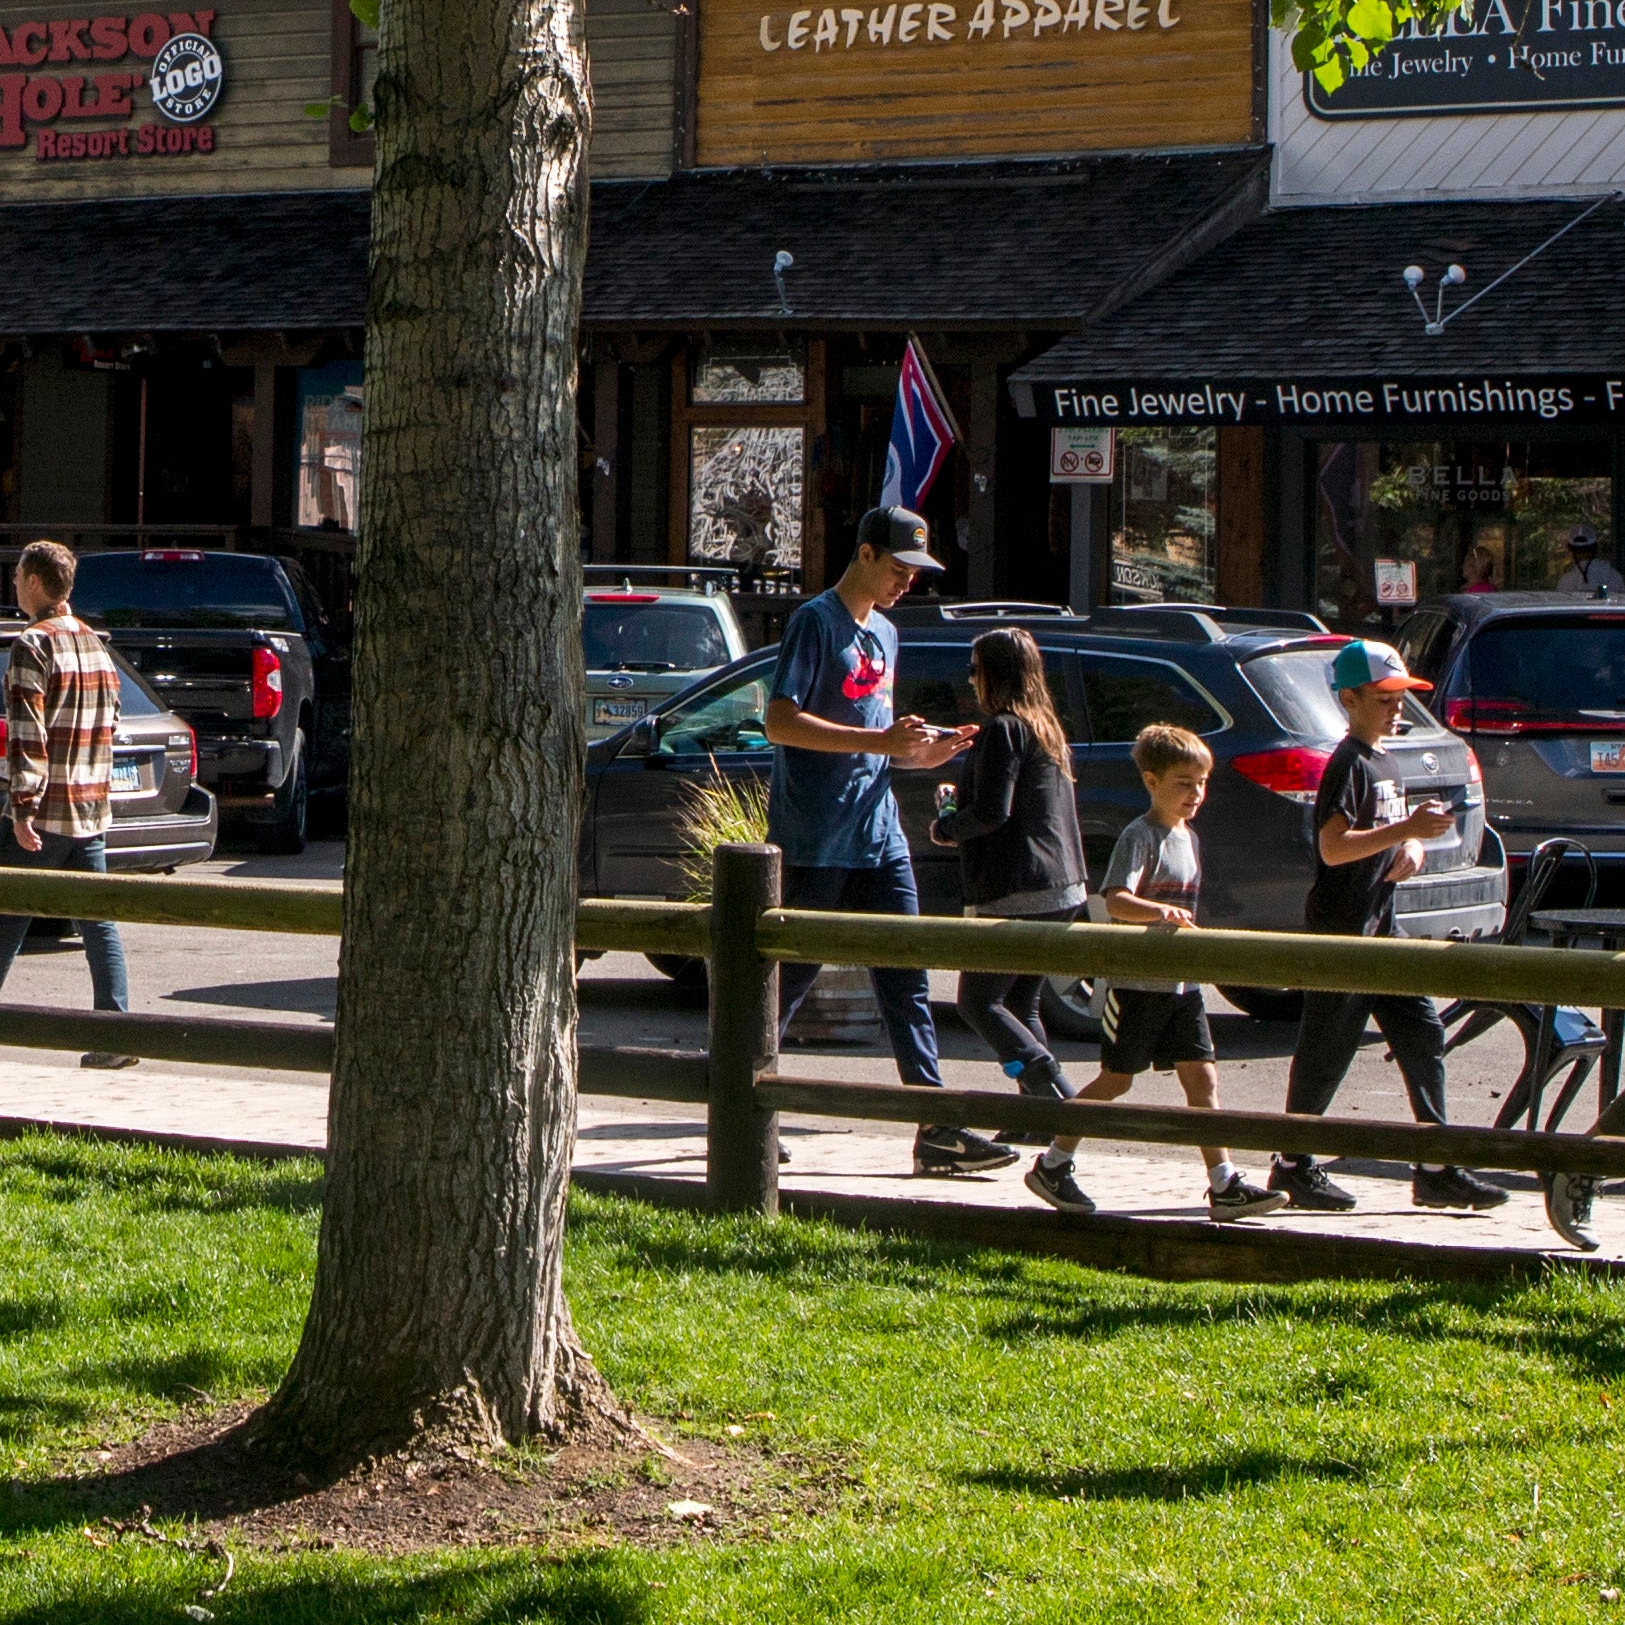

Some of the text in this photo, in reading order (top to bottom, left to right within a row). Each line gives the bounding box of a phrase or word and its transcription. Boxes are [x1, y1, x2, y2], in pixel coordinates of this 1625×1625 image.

[759, 2, 956, 53] LEATHER
[158, 39, 213, 74] OFFICIAL
[1388, 49, 1475, 80] Jewelry
[1508, 45, 1583, 70] Home
[149, 54, 223, 103] LOGO
[165, 88, 213, 115] STORE
[37, 123, 214, 160] Resort Store
[1055, 386, 1118, 418] Fine
[1127, 385, 1245, 422] Jewelry
[1276, 383, 1374, 414] Home
[1384, 380, 1574, 419] Furnishings
[1408, 466, 1517, 485] BELLA
[1416, 489, 1511, 502] FINE GOODS
